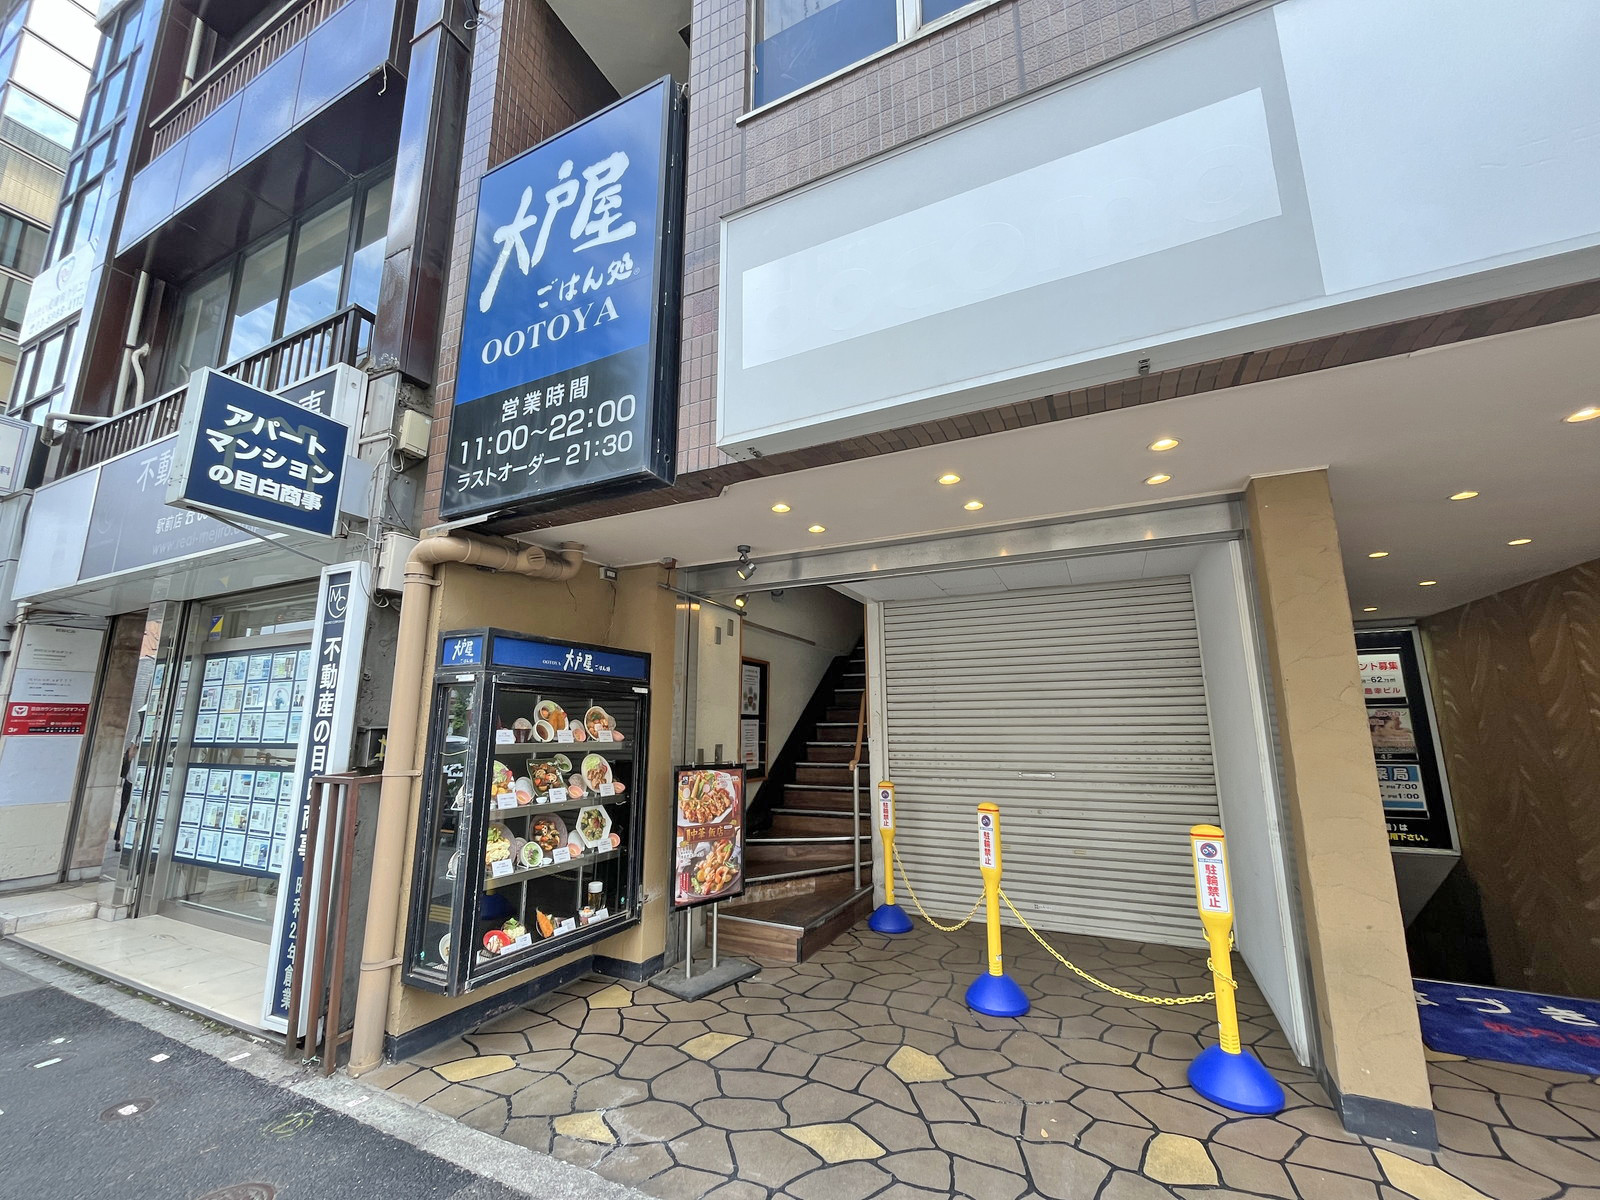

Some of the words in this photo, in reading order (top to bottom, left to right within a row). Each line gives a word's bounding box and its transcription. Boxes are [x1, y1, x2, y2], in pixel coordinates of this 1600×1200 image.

[479, 151, 638, 314] 大戸屋
[536, 251, 635, 309] ごはん処
[481, 295, 619, 365] OOTOYA
[501, 375, 590, 422] 営業時間
[224, 404, 327, 456] アパート
[206, 428, 335, 485] マンション
[457, 455, 560, 492] ラストオーダー
[566, 430, 634, 467] 21:30
[208, 464, 323, 511] の目白商事
[155, 513, 184, 535] 駅前店
[452, 638, 474, 661] 大戸屋
[563, 648, 594, 673] 大戸屋
[983, 831, 992, 865] 駐輪禁止
[1205, 864, 1221, 908] 駐輪禁止
